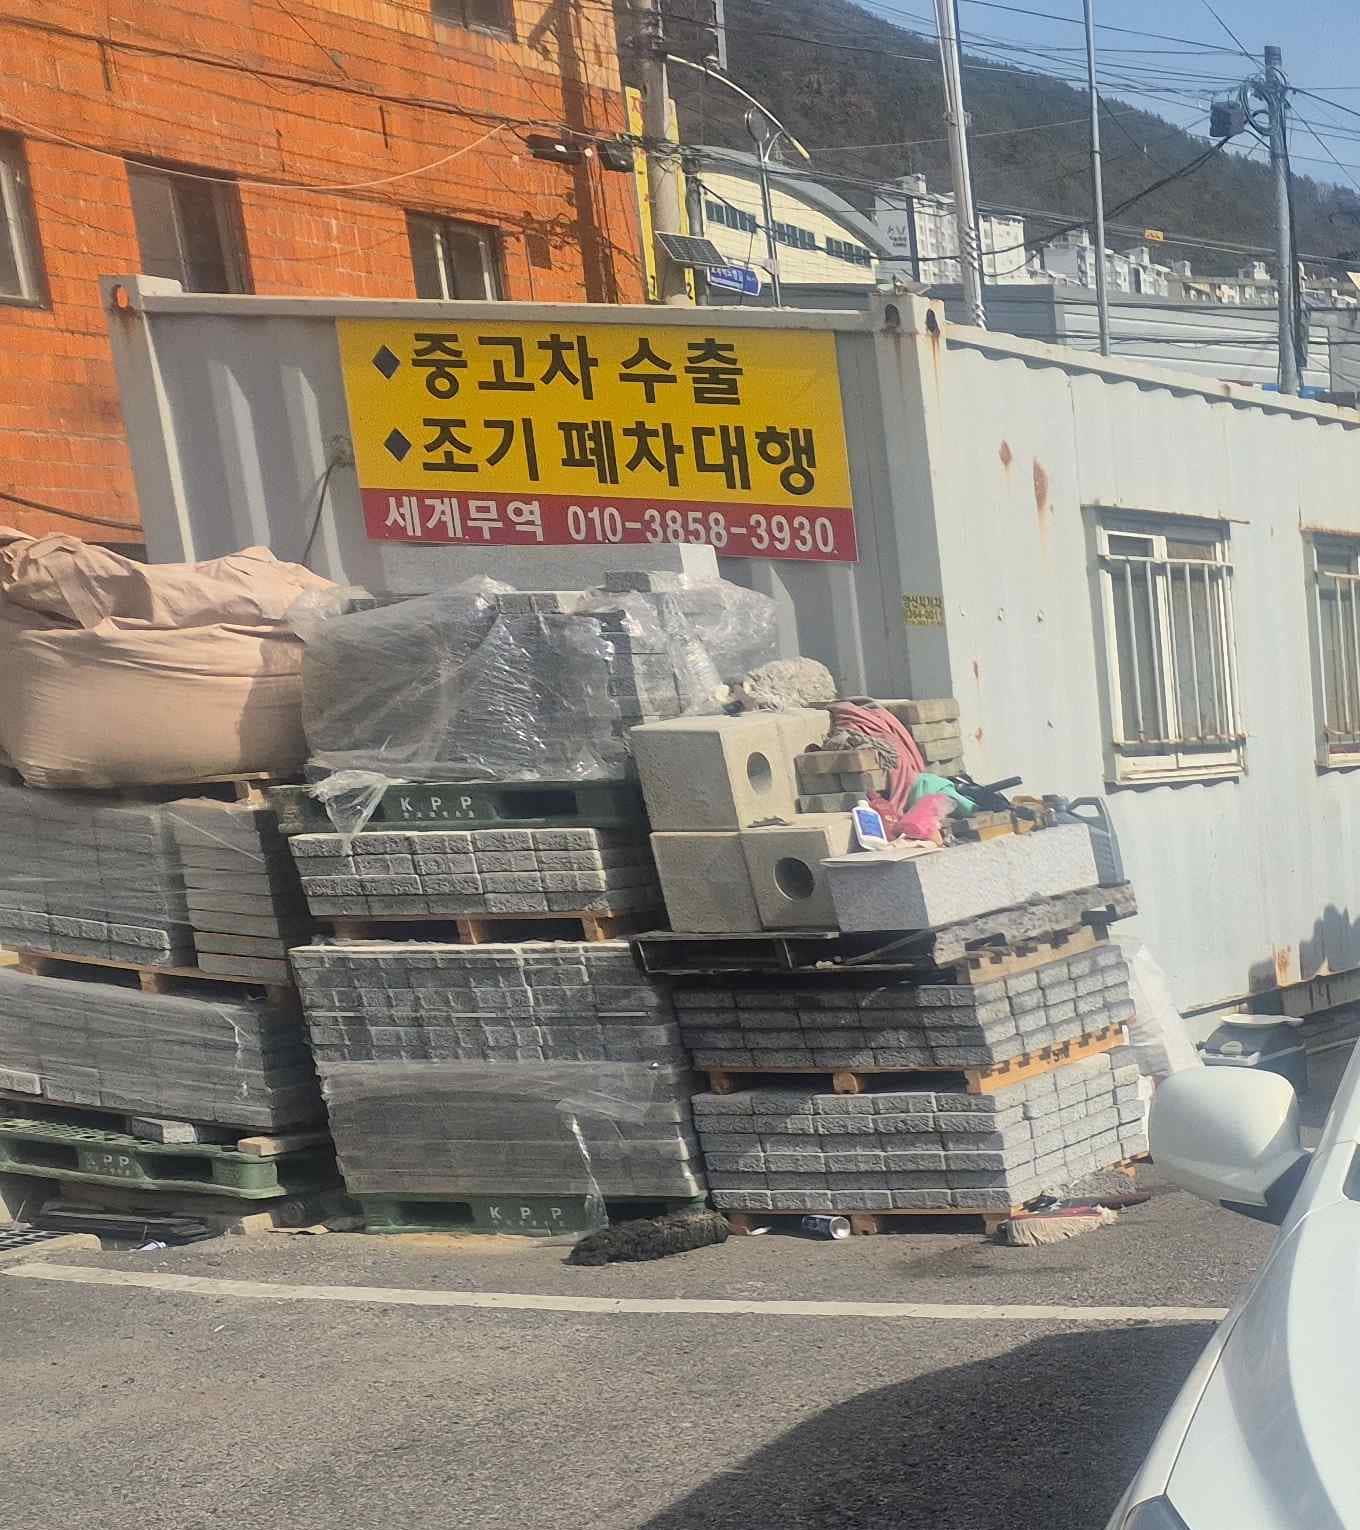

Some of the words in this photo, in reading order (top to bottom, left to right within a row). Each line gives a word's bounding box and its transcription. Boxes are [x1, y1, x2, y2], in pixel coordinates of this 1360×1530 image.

[411, 333, 599, 401] 중고차
[619, 337, 743, 405] 수출
[422, 417, 540, 482] 조기
[557, 419, 816, 496] 폐차대행
[385, 495, 543, 541] 세계무역
[567, 504, 834, 553] 010-3858-3930
